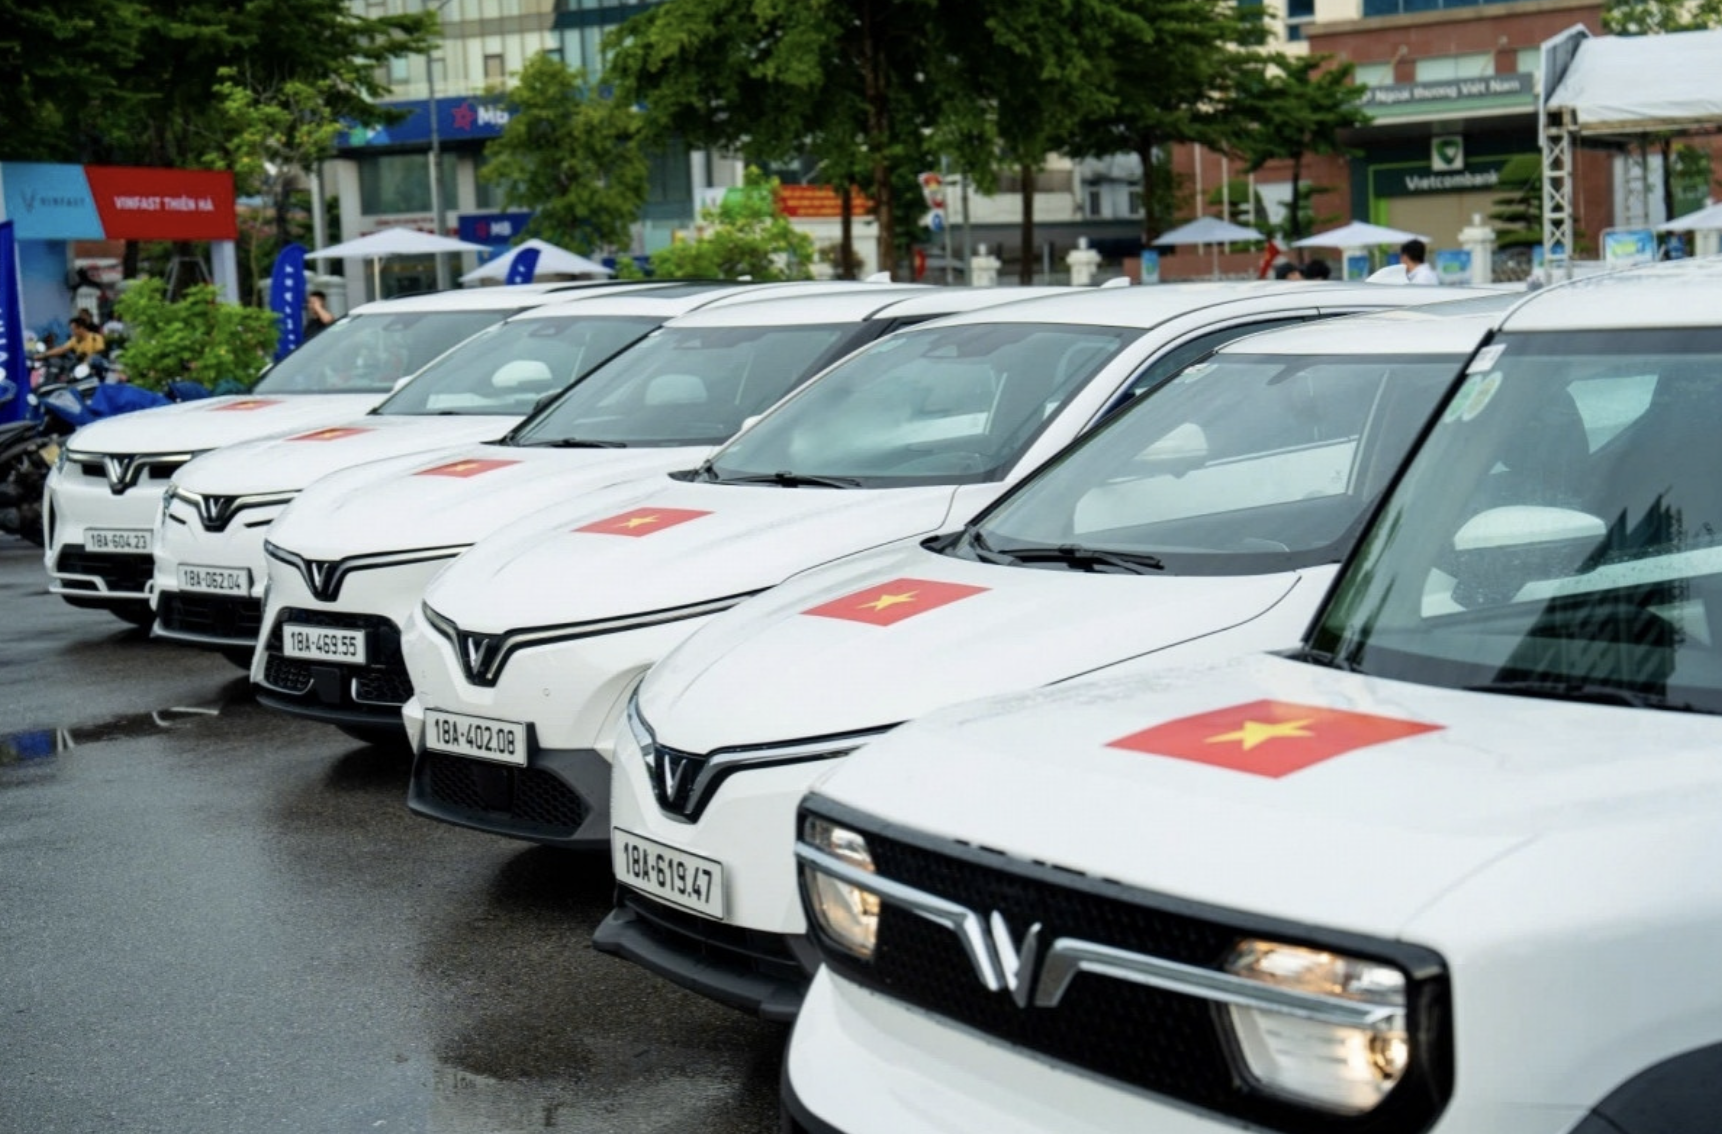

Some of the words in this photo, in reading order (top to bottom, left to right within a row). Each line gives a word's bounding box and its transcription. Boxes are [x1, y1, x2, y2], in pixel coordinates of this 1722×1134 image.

[1405, 168, 1498, 191] Vietcombank
[113, 195, 161, 211] VINFAST
[90, 533, 148, 550] 18A-604.23
[183, 569, 242, 590] 18A-062.04
[290, 631, 357, 657] 18A-469.55
[434, 718, 516, 756] 18A-402.08
[623, 841, 713, 904] 18A-619.47
